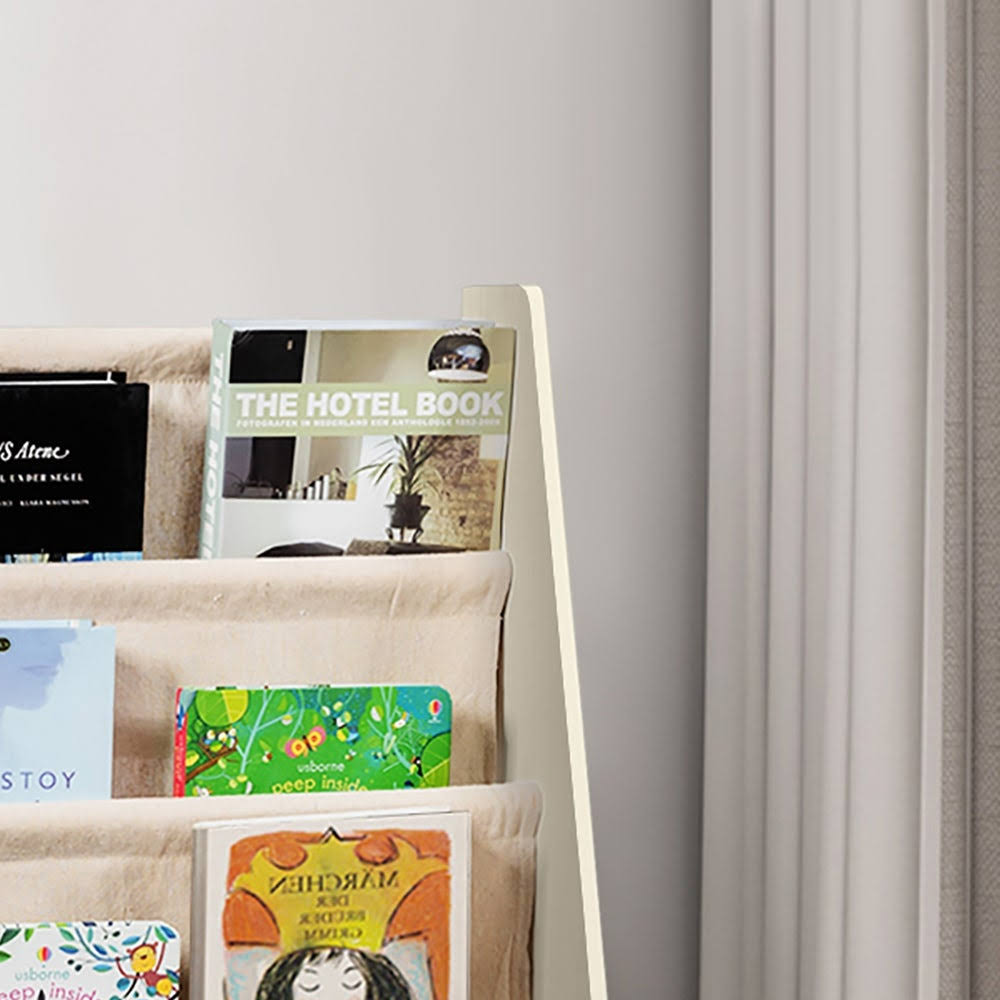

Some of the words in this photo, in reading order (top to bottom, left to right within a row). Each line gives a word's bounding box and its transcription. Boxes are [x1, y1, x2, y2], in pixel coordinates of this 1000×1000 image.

[208, 353, 224, 430] THE
[236, 391, 299, 417] THE
[306, 391, 408, 417] HOTEL
[416, 390, 504, 417] BOOK
[297, 760, 345, 772] usborne
[15, 968, 70, 981] usborne
